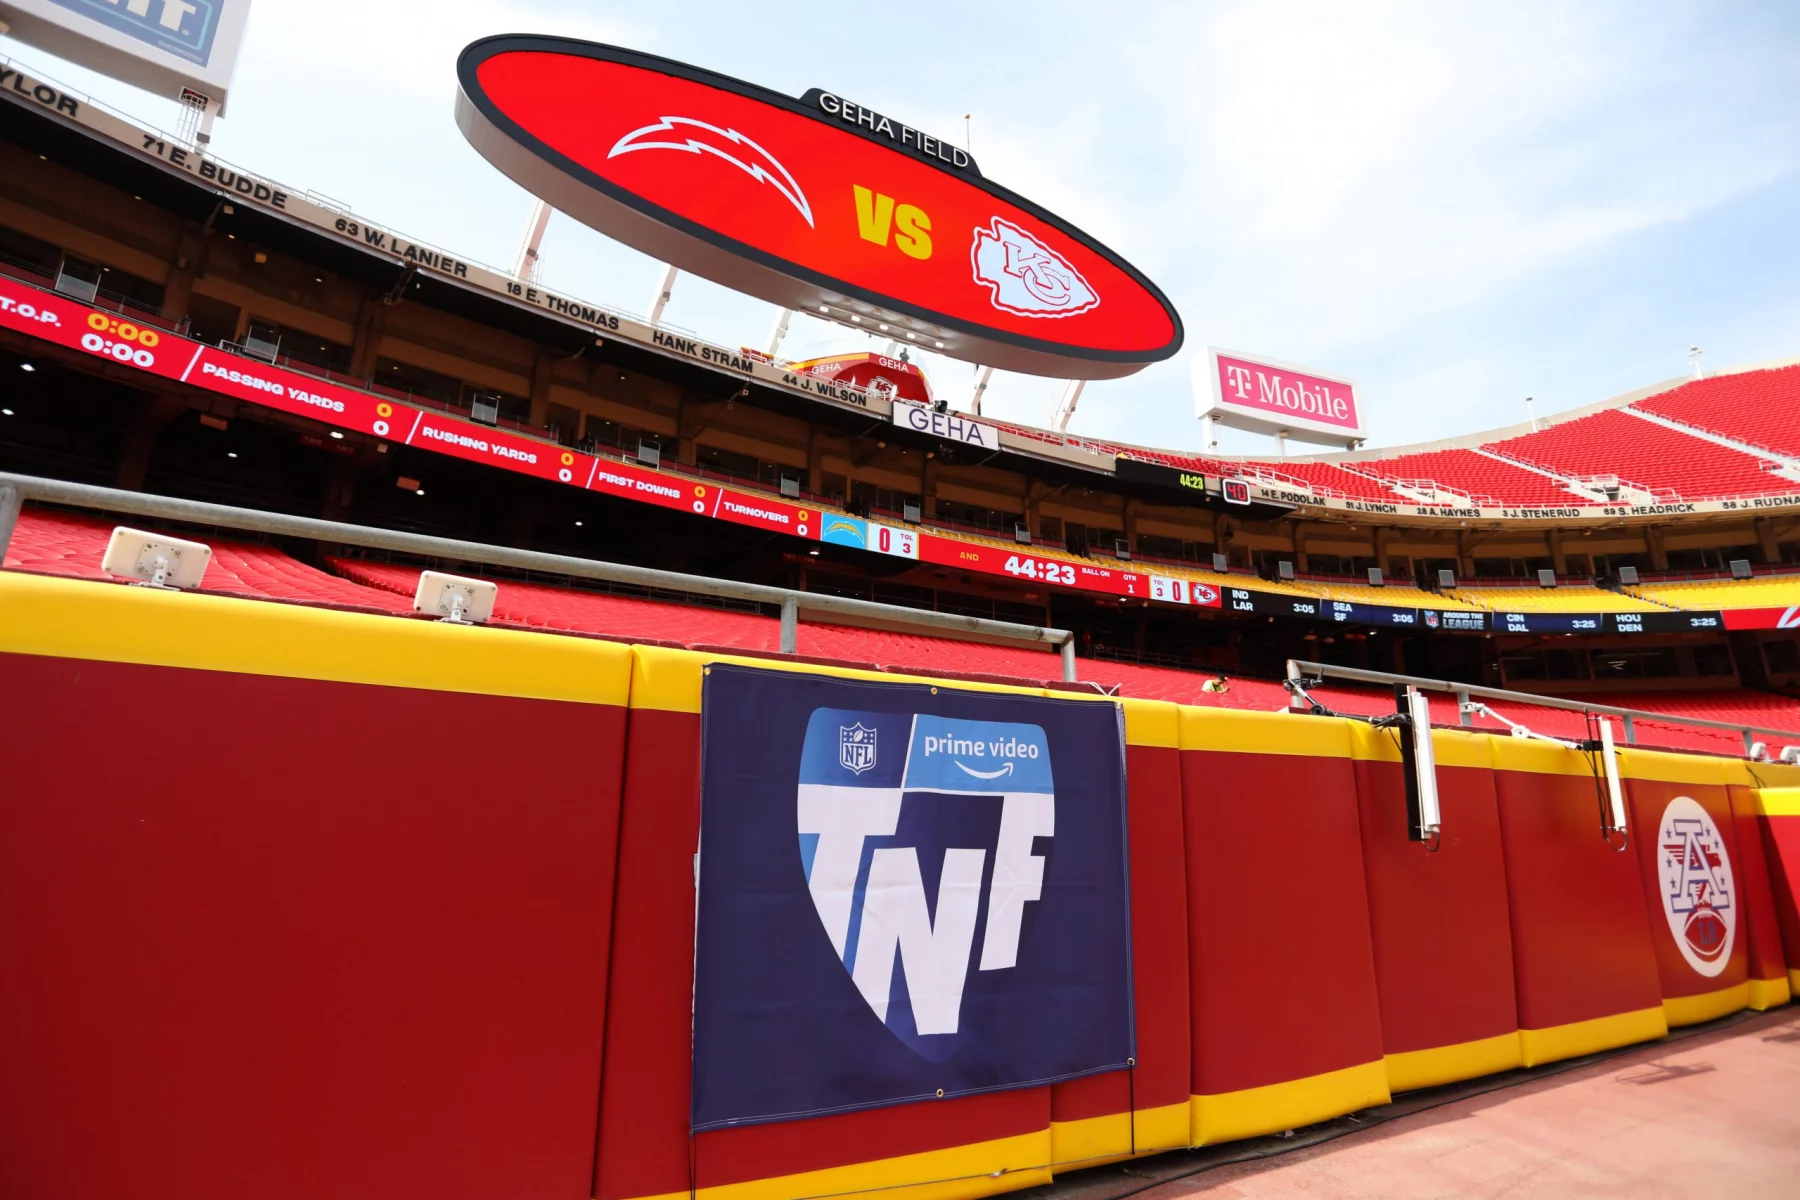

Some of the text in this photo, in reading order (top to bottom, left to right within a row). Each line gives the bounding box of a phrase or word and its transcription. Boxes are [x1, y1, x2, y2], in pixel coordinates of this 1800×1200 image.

[819, 93, 969, 168] GEHA FIELD
[142, 134, 287, 209] 71 E. BUDDE
[853, 183, 933, 260] VS
[335, 218, 468, 277] 63 W. LANIER
[0, 295, 61, 327] T.O.P.
[507, 282, 619, 330] 18 E. THOMAS
[87, 312, 160, 347] 0:00
[81, 333, 155, 368] 0:00
[652, 331, 753, 373] HANK STRAM
[811, 362, 842, 375] GEHA
[878, 357, 909, 373] GEHA
[202, 362, 345, 413] PASSING YARDS
[782, 374, 867, 407] 44 J. WILSON
[1255, 371, 1349, 421] Mobile
[376, 402, 393, 418] 0
[372, 420, 390, 436] 0
[908, 408, 984, 446] GEHA
[422, 426, 537, 464] RUSHING YARDS
[560, 452, 574, 466] 0
[558, 468, 573, 482] 0
[1180, 473, 1203, 490] 44:23
[599, 471, 681, 499] FIRST DOWNS
[694, 486, 706, 498] 0
[1227, 483, 1247, 501] 40
[1260, 489, 1326, 506] 14 E. PODOLAK
[693, 500, 705, 513] 0
[1365, 503, 1397, 513] LYNCH
[1618, 507, 1629, 516] S.
[1632, 503, 1695, 516] HEADRICK
[1740, 499, 1752, 508] J.
[723, 501, 789, 524] TURNOVERS
[798, 510, 809, 522] 0
[1429, 507, 1438, 516] A.
[1440, 508, 1481, 517] HAYNES
[1511, 509, 1519, 518] J.
[1521, 508, 1580, 518] STENERUD
[797, 524, 808, 536] 0
[879, 527, 890, 553] 0
[900, 533, 914, 541] TOL
[902, 543, 911, 554] 3
[960, 551, 979, 562] AND
[1004, 555, 1076, 585] 44:23
[1082, 567, 1110, 578] BALL ON
[1123, 574, 1137, 582] QTR
[1127, 584, 1135, 594] 1
[1156, 588, 1164, 597] 3
[1172, 581, 1182, 601] 0
[1232, 589, 1249, 600] IND
[1233, 600, 1254, 611] LAR
[1293, 603, 1315, 614] 3:05
[1333, 602, 1353, 612] SEA
[1334, 612, 1347, 621] SF
[1392, 613, 1413, 624] 3:05
[1443, 611, 1484, 620] AROUND THE
[1506, 613, 1524, 622] CIN
[1616, 613, 1641, 623] HOU
[1690, 617, 1717, 627] 3:25
[1443, 619, 1484, 630] LEAGUE
[1508, 623, 1529, 632] DAL
[1572, 619, 1596, 629] 3:25
[1617, 623, 1643, 632] DEN
[925, 733, 1039, 759] prime video
[843, 744, 872, 765] NFL
[797, 784, 1055, 1035] TNF
